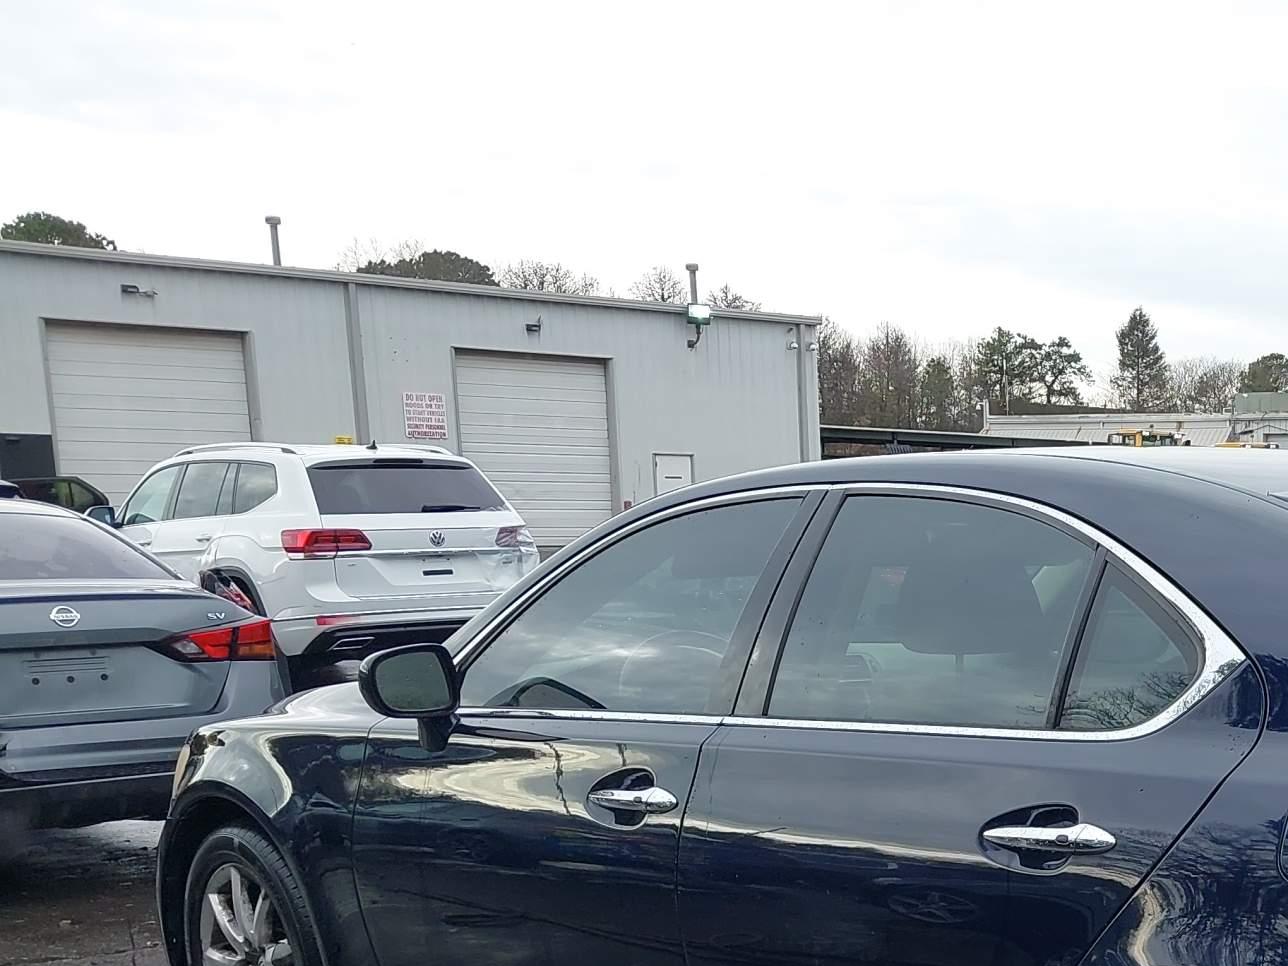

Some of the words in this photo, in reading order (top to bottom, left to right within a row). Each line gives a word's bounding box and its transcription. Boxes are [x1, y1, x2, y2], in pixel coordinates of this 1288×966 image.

[405, 393, 413, 402] DO
[415, 394, 426, 402] NOT
[428, 395, 442, 403] OPEN
[207, 612, 225, 620] SV
